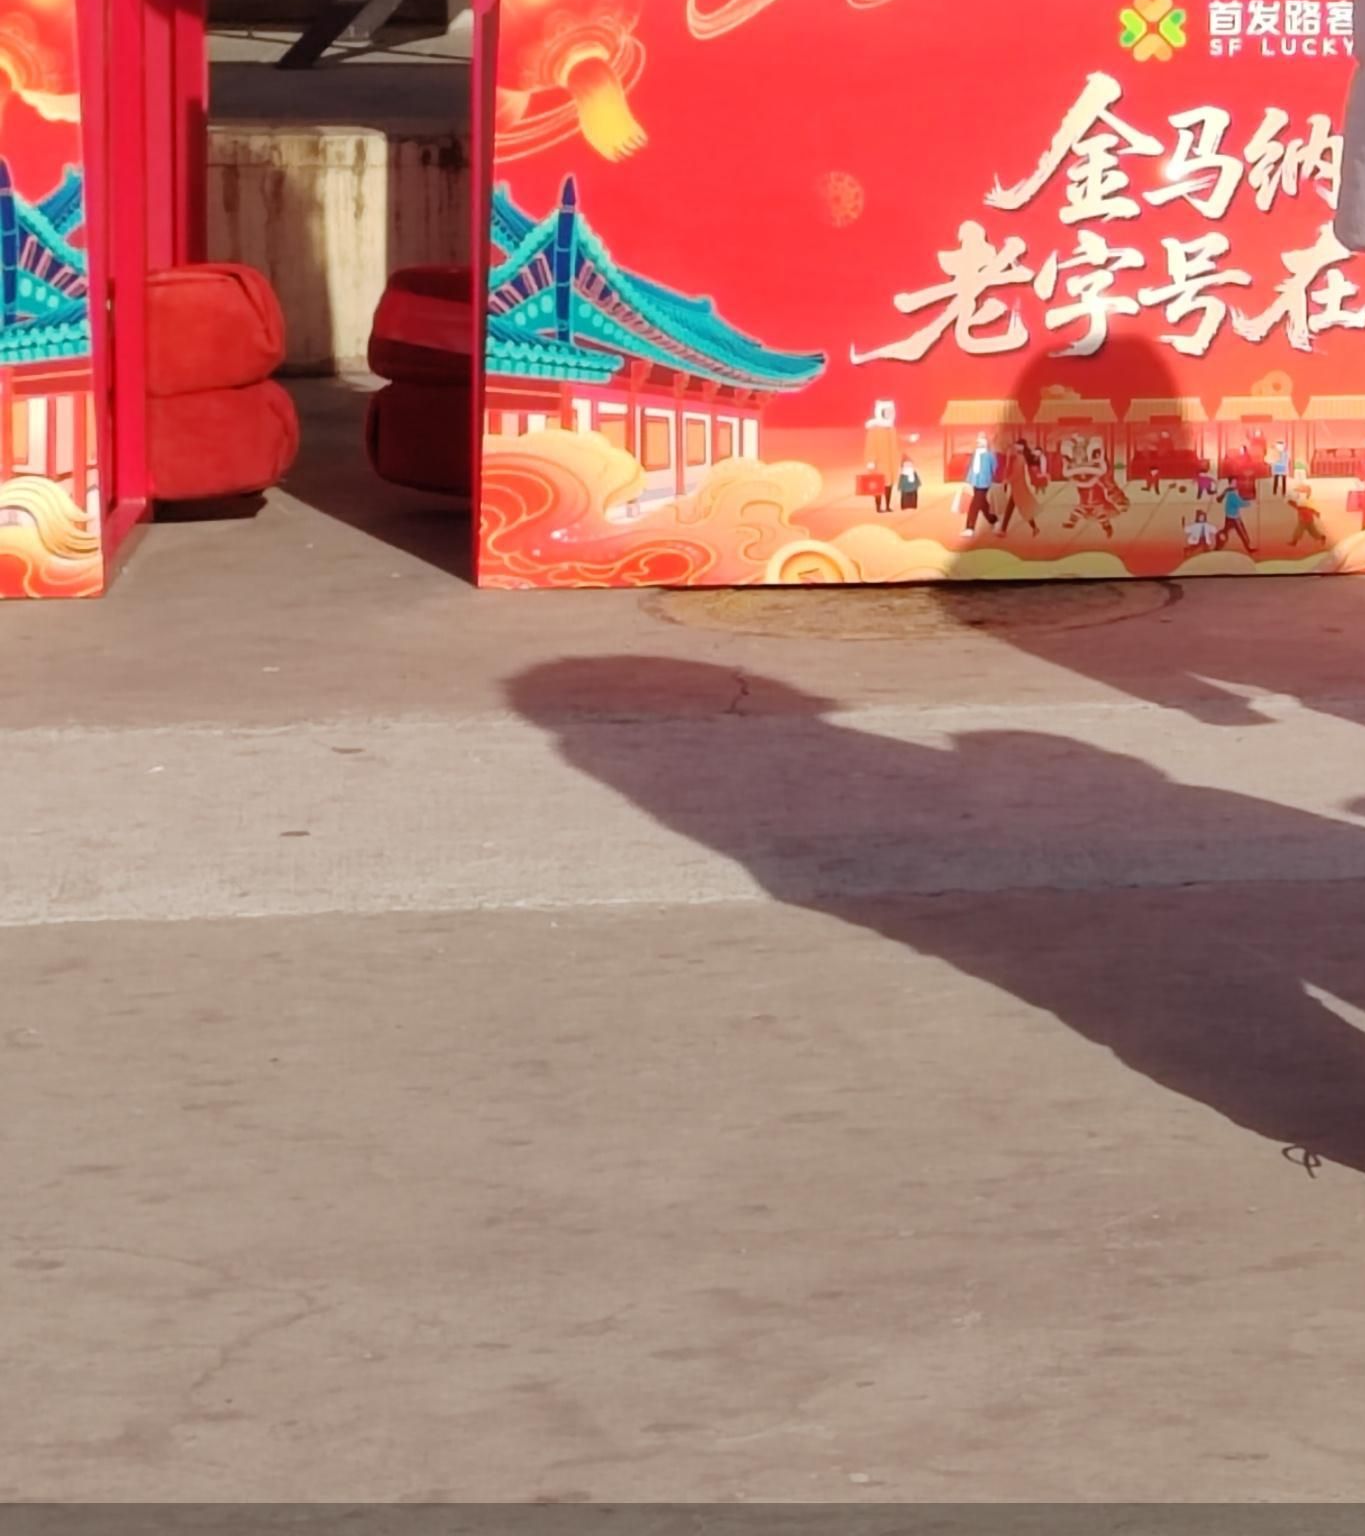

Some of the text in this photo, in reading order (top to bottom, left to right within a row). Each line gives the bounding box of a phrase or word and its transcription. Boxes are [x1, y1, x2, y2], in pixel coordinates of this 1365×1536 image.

[1208, 0, 1353, 37] 首发路客
[1209, 38, 1354, 56] SF LUCKY
[984, 71, 1344, 225] 金马纳
